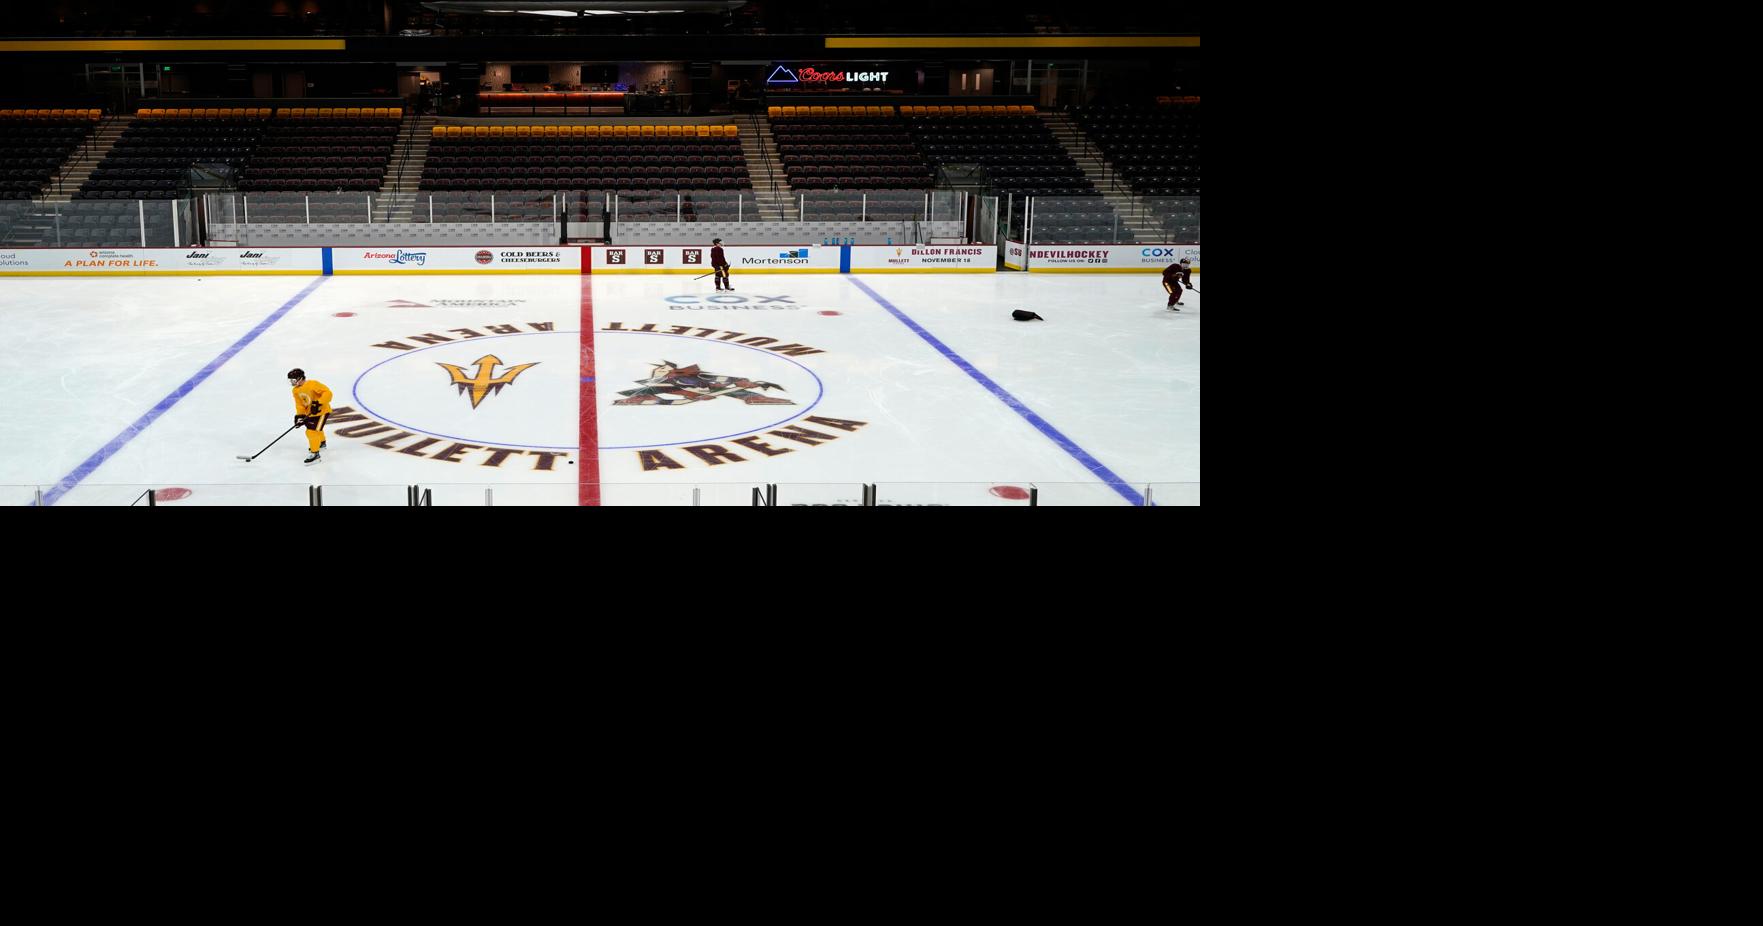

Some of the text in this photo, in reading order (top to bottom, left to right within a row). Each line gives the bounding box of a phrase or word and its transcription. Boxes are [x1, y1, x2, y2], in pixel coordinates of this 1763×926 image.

[798, 67, 889, 81] Coors LIGHT
[186, 251, 210, 259] Jani
[240, 250, 263, 258] Jani
[389, 249, 427, 265] Lottery
[1142, 248, 1174, 257] COX
[612, 255, 620, 263] S
[650, 255, 658, 263] S
[688, 255, 696, 263] S
[664, 295, 795, 304] COX
[370, 321, 554, 350] ARENA
[601, 322, 826, 356] MULLETT
[326, 406, 568, 471] MULLETT
[637, 414, 869, 471] ARENA
